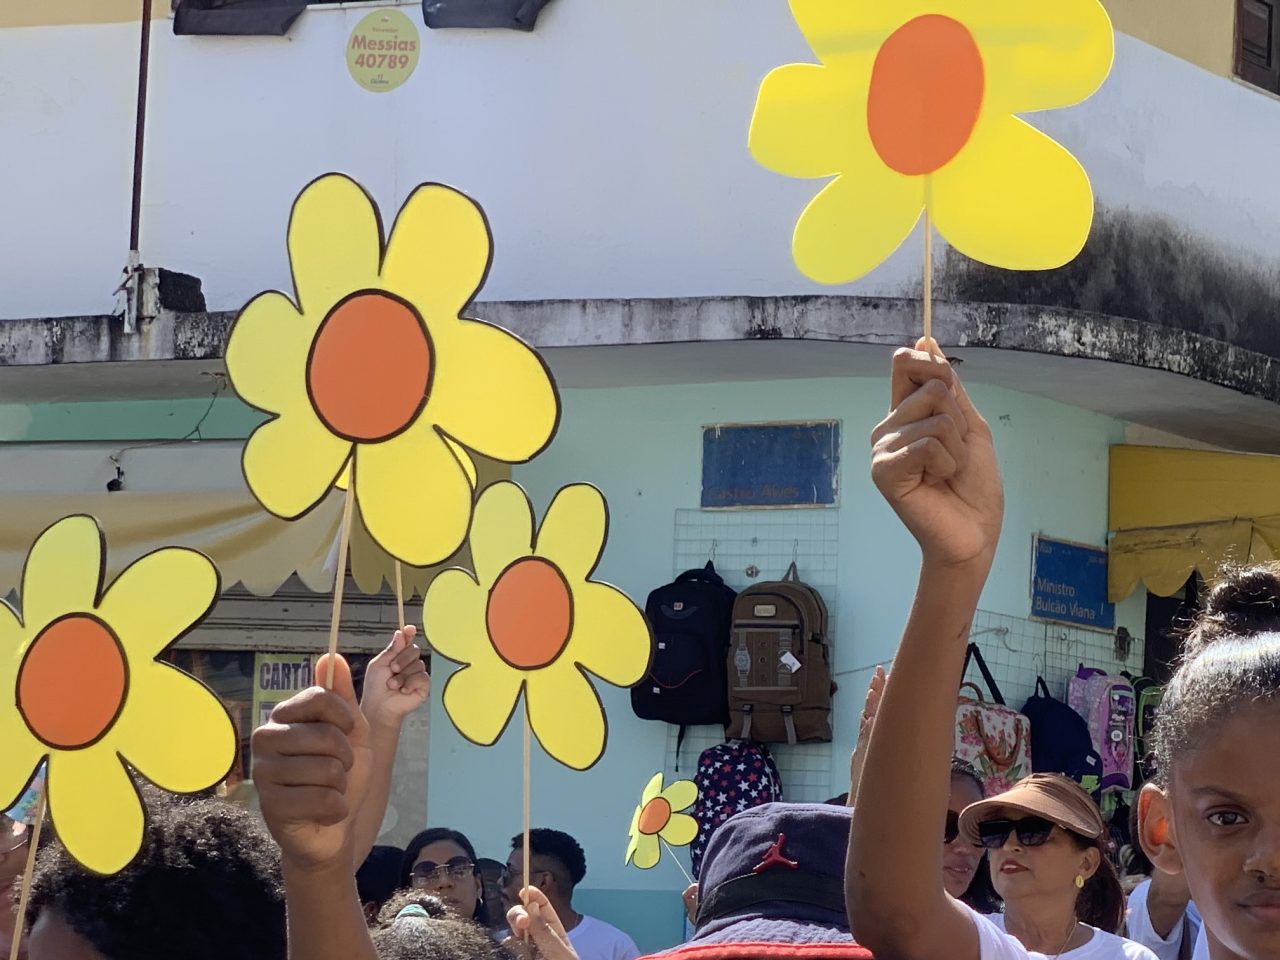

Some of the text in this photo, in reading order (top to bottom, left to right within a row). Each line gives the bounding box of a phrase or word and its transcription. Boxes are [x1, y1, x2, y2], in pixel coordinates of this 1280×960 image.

[351, 35, 417, 52] Messias
[354, 53, 410, 69] 40789
[1036, 577, 1076, 597] Ministro
[1069, 601, 1096, 619] Viana
